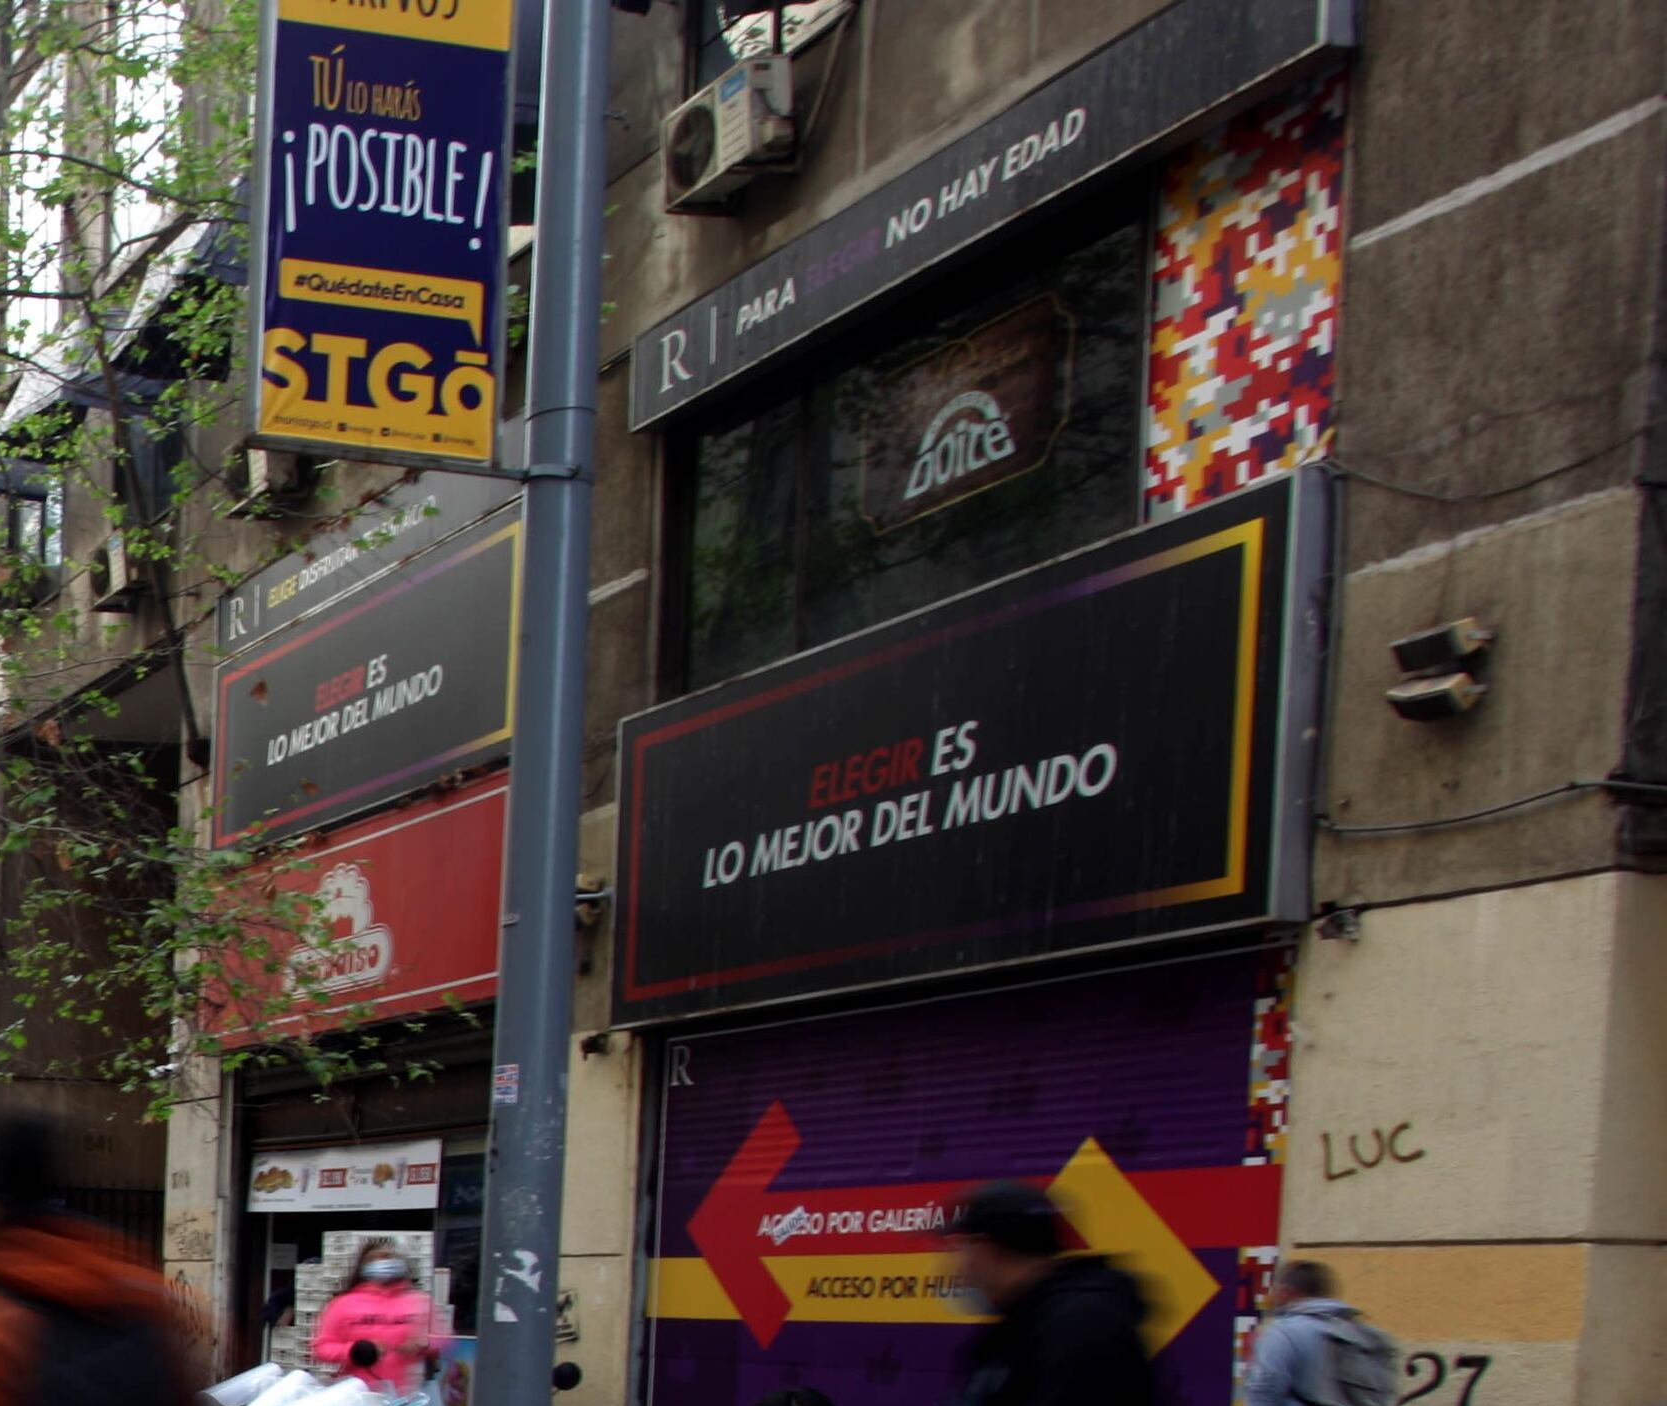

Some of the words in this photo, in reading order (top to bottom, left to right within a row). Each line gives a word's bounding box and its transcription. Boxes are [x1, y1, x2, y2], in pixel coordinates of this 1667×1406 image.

[308, 44, 346, 110] TÚ
[346, 80, 367, 113] LO
[371, 80, 421, 121] HARÁS
[282, 123, 494, 250] ¡POSIBLE!
[659, 329, 693, 394] R
[735, 278, 795, 336] PARA
[885, 198, 933, 249] NO
[936, 157, 999, 220] HAY
[1002, 107, 1086, 182] EDAD
[294, 273, 465, 309] #QuédateEnCasa
[228, 597, 248, 641] R
[366, 653, 388, 689] ES
[267, 734, 288, 766] LO
[288, 712, 340, 757] MEJOR
[341, 697, 370, 734] DEL
[371, 664, 443, 721] MUNDO
[808, 737, 924, 809] ELEGIR
[931, 720, 978, 777] ES
[702, 841, 744, 889] LO
[749, 809, 863, 877] MEJOR
[870, 790, 933, 848] DEL
[942, 743, 1117, 830] MUNDO
[670, 1045, 694, 1086] R
[1322, 1122, 1425, 1181] LUC
[757, 1211, 824, 1237] ACSO
[826, 1211, 863, 1234] POR
[867, 1201, 945, 1233] GALERÍA
[806, 1276, 875, 1299] ACCESO
[877, 1276, 917, 1298] POR
